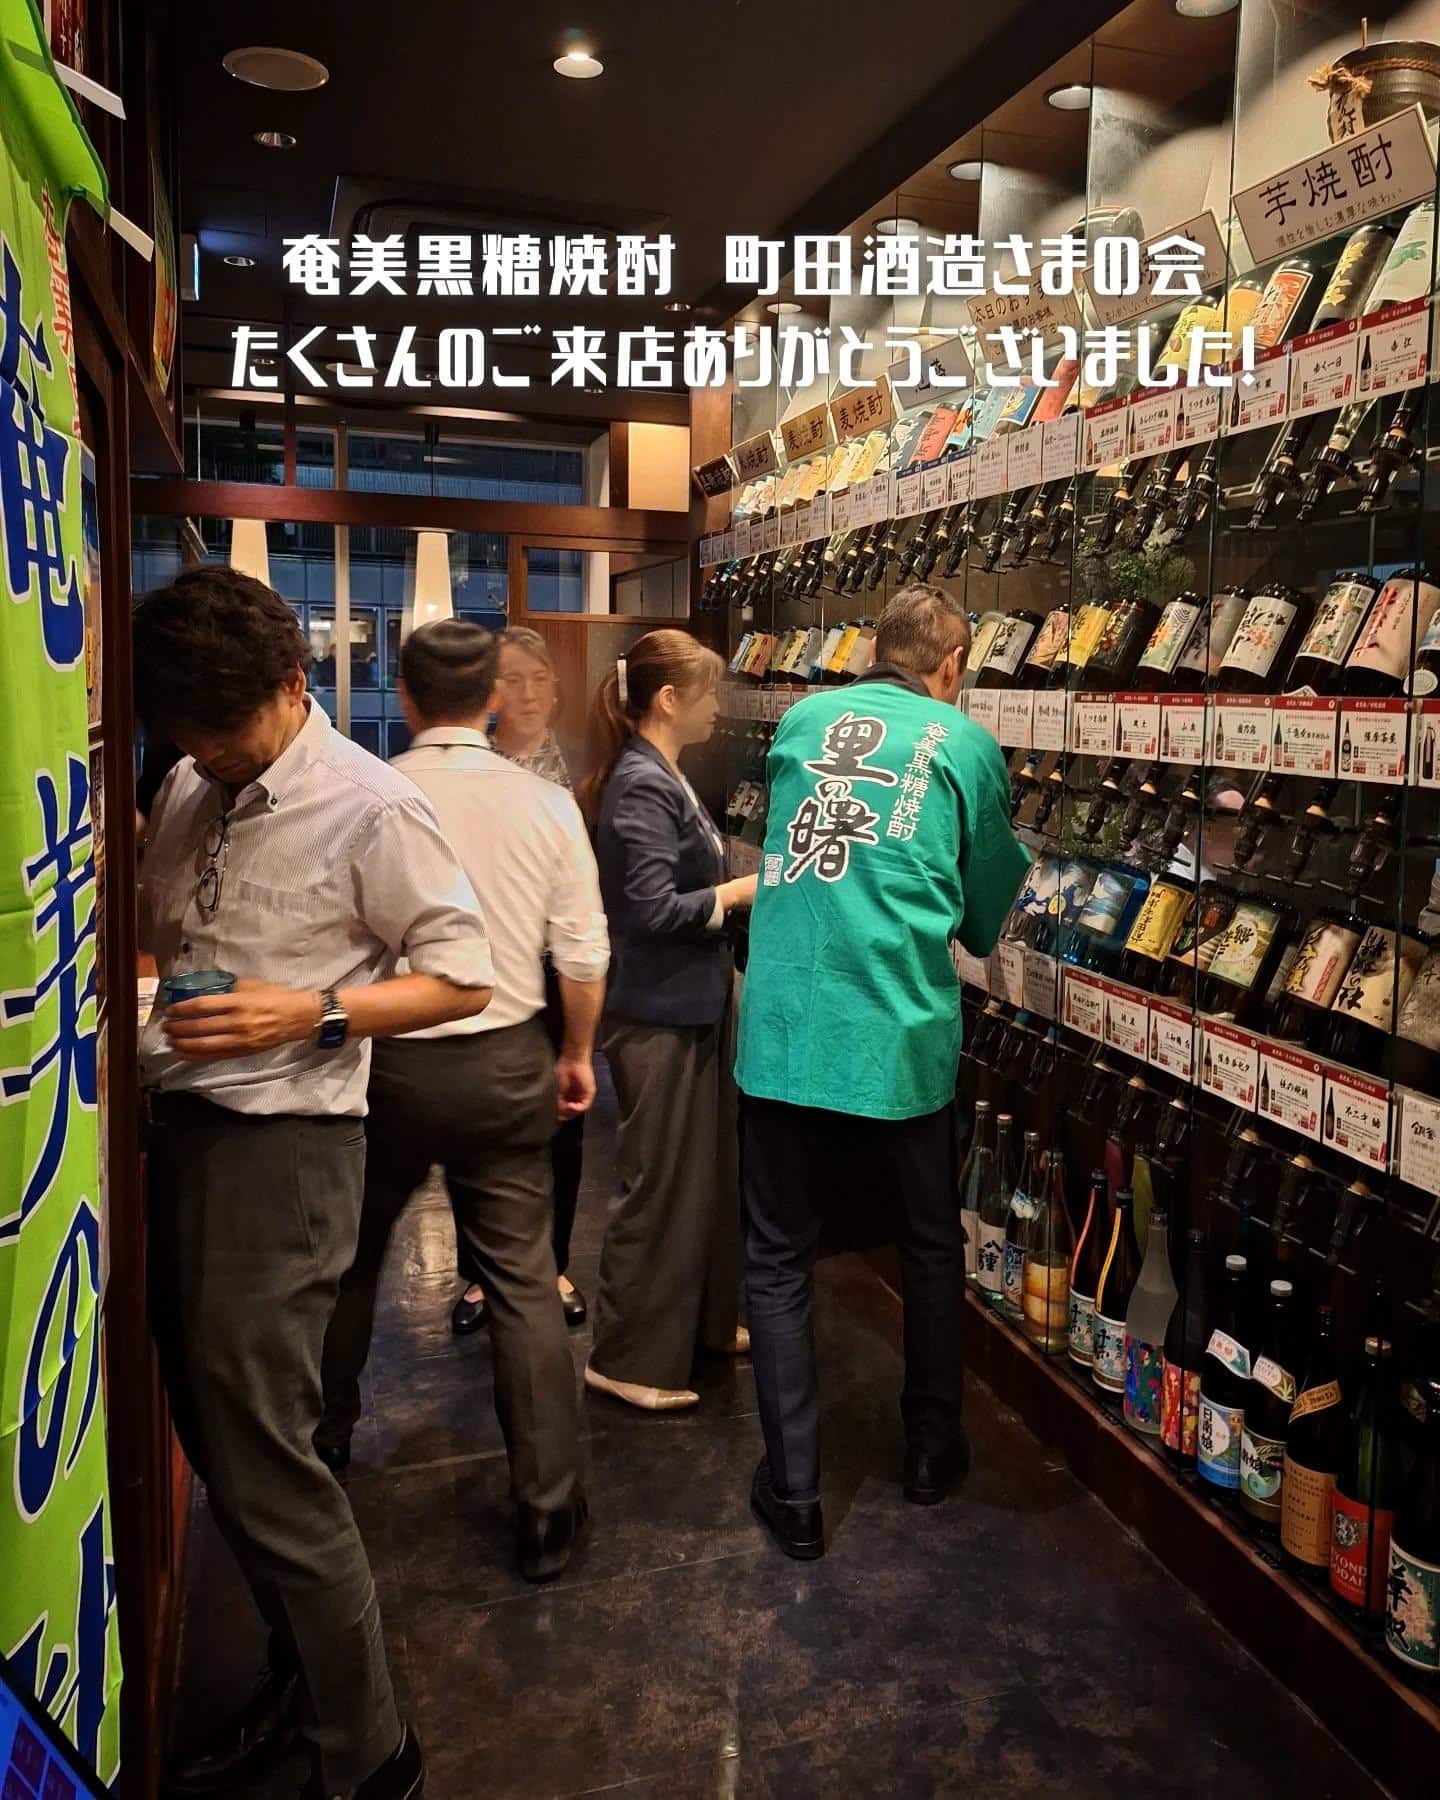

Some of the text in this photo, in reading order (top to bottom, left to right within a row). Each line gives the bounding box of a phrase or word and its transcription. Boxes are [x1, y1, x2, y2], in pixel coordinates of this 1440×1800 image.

[1259, 133, 1393, 227] 芋焼酎
[838, 390, 885, 430] 麦焼酎
[784, 711, 899, 884] 里の曙
[886, 721, 950, 842] 奄美黒糖焼酎
